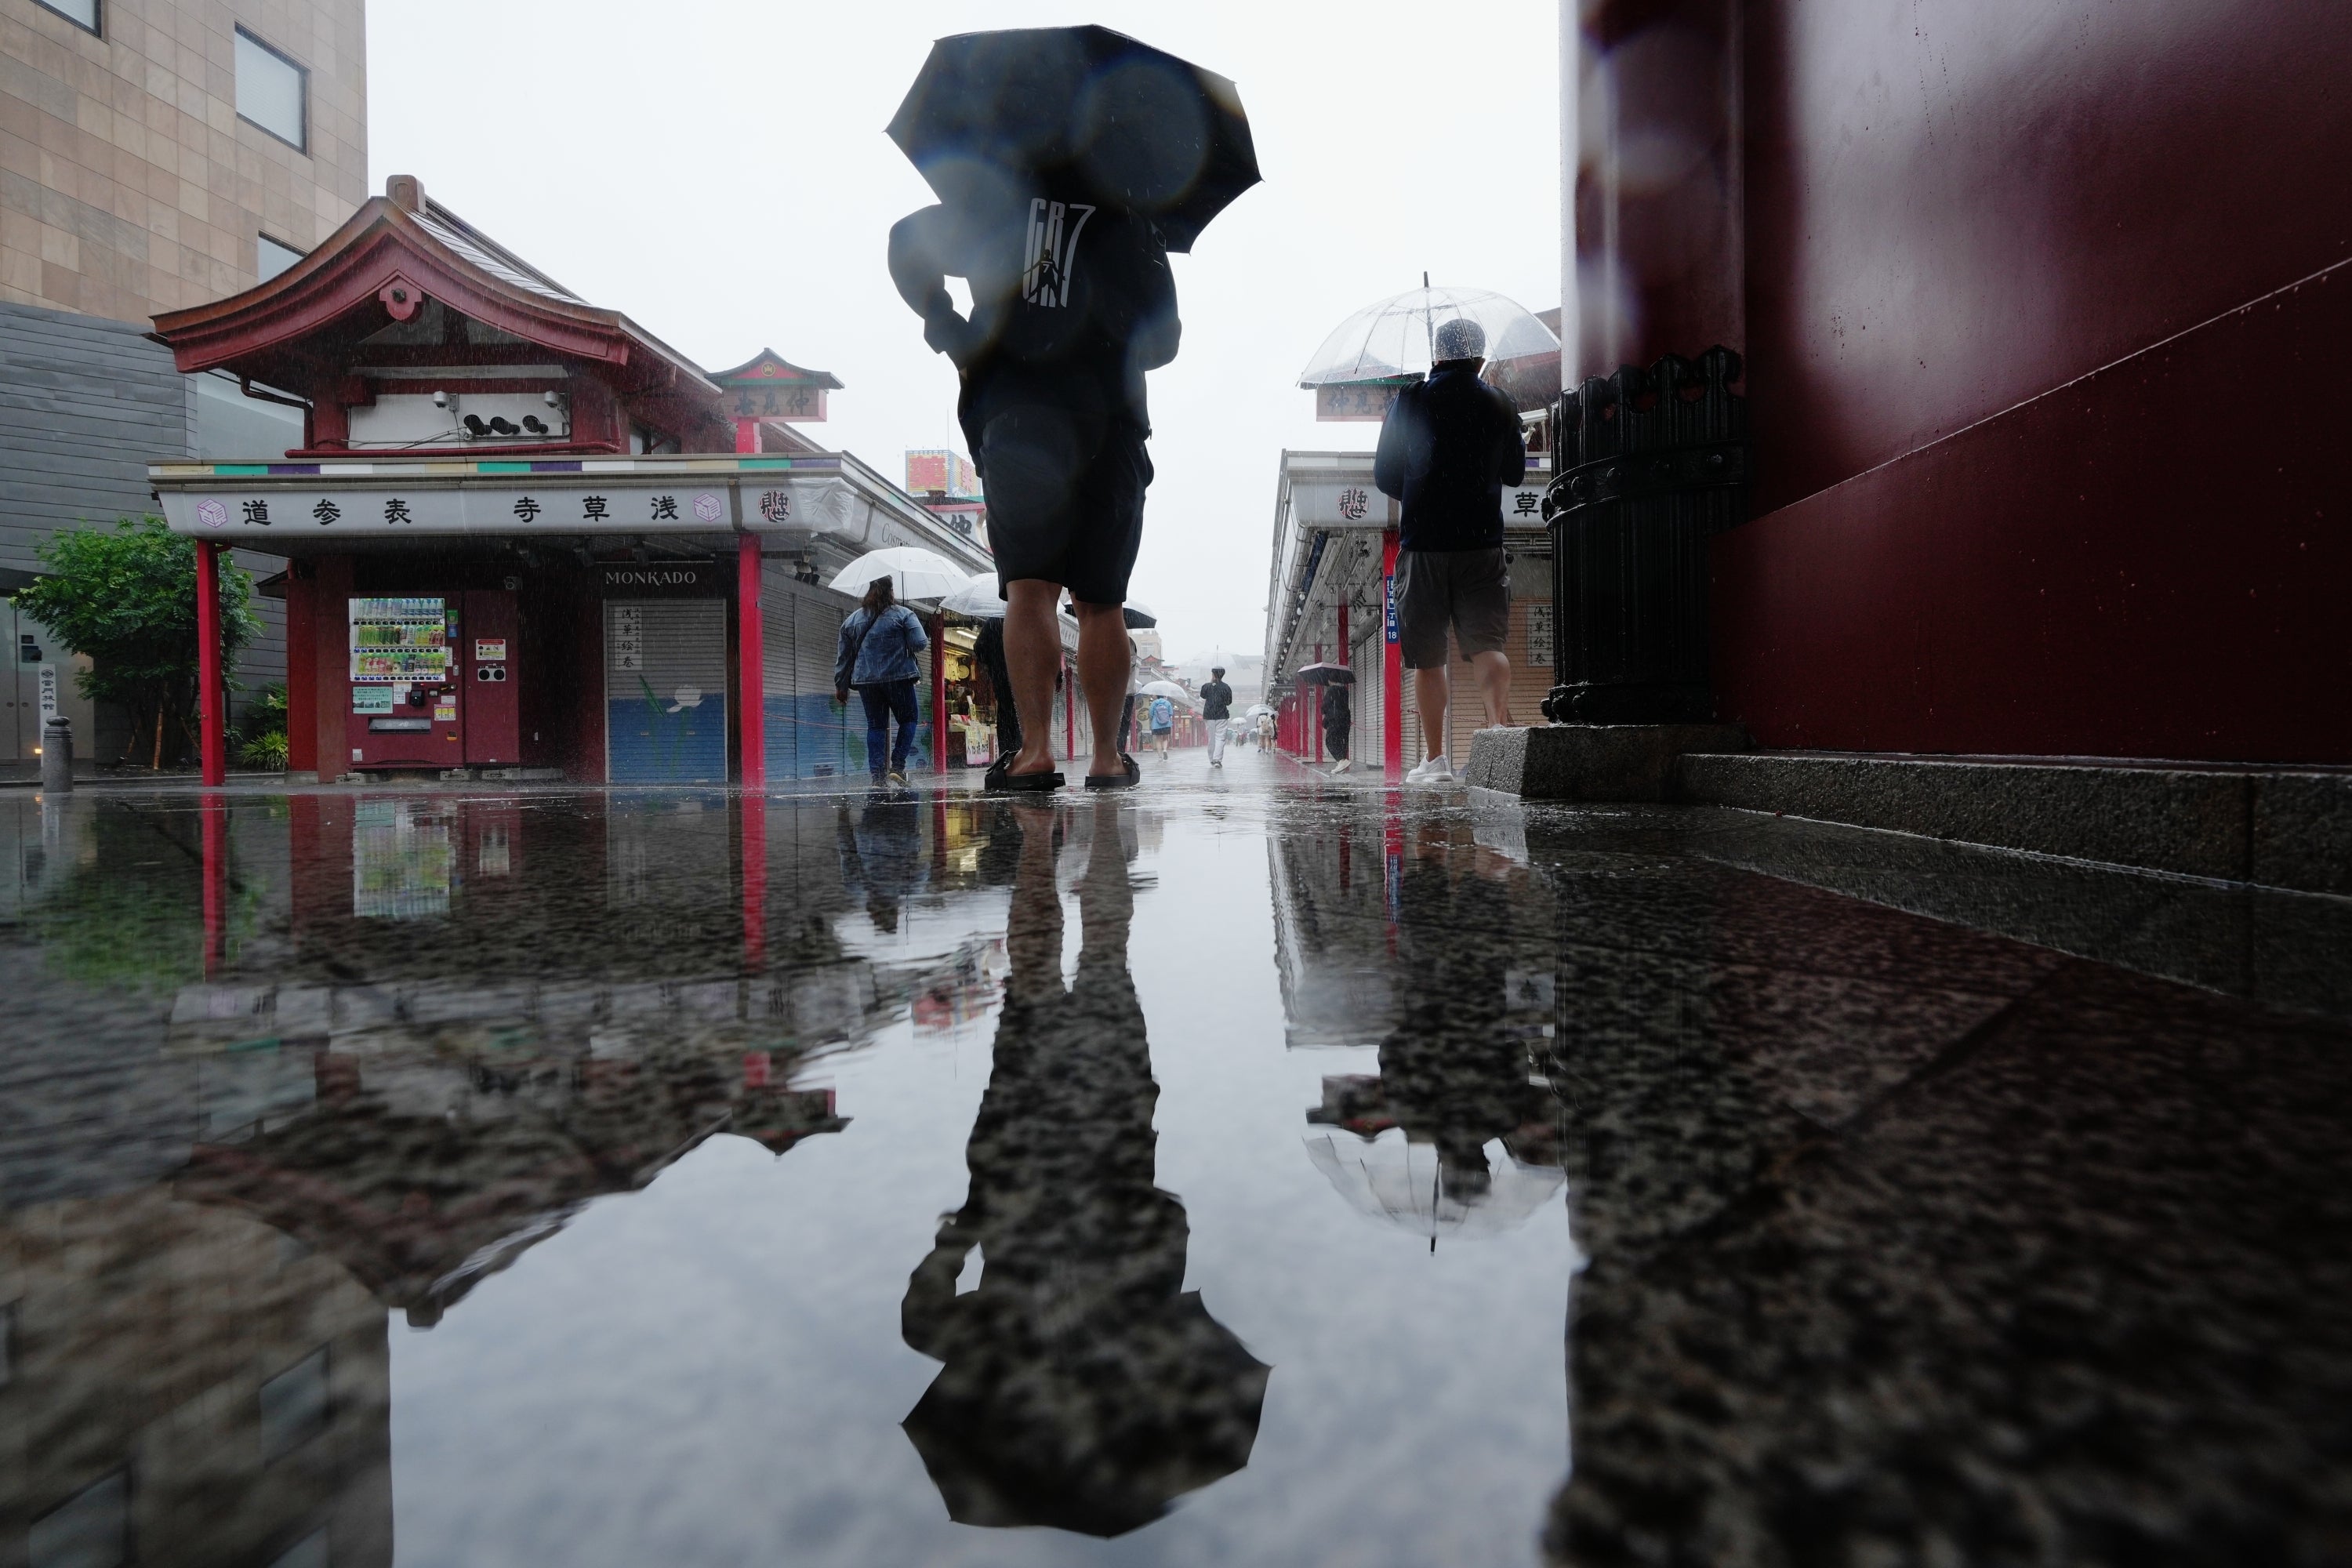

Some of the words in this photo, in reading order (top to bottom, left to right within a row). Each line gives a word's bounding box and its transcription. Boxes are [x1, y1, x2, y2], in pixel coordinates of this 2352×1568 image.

[1022, 198, 1096, 308] CR7
[1513, 492, 1539, 517] 草
[605, 572, 696, 586] MONKADO
[621, 608, 633, 668] 浅草絵巻
